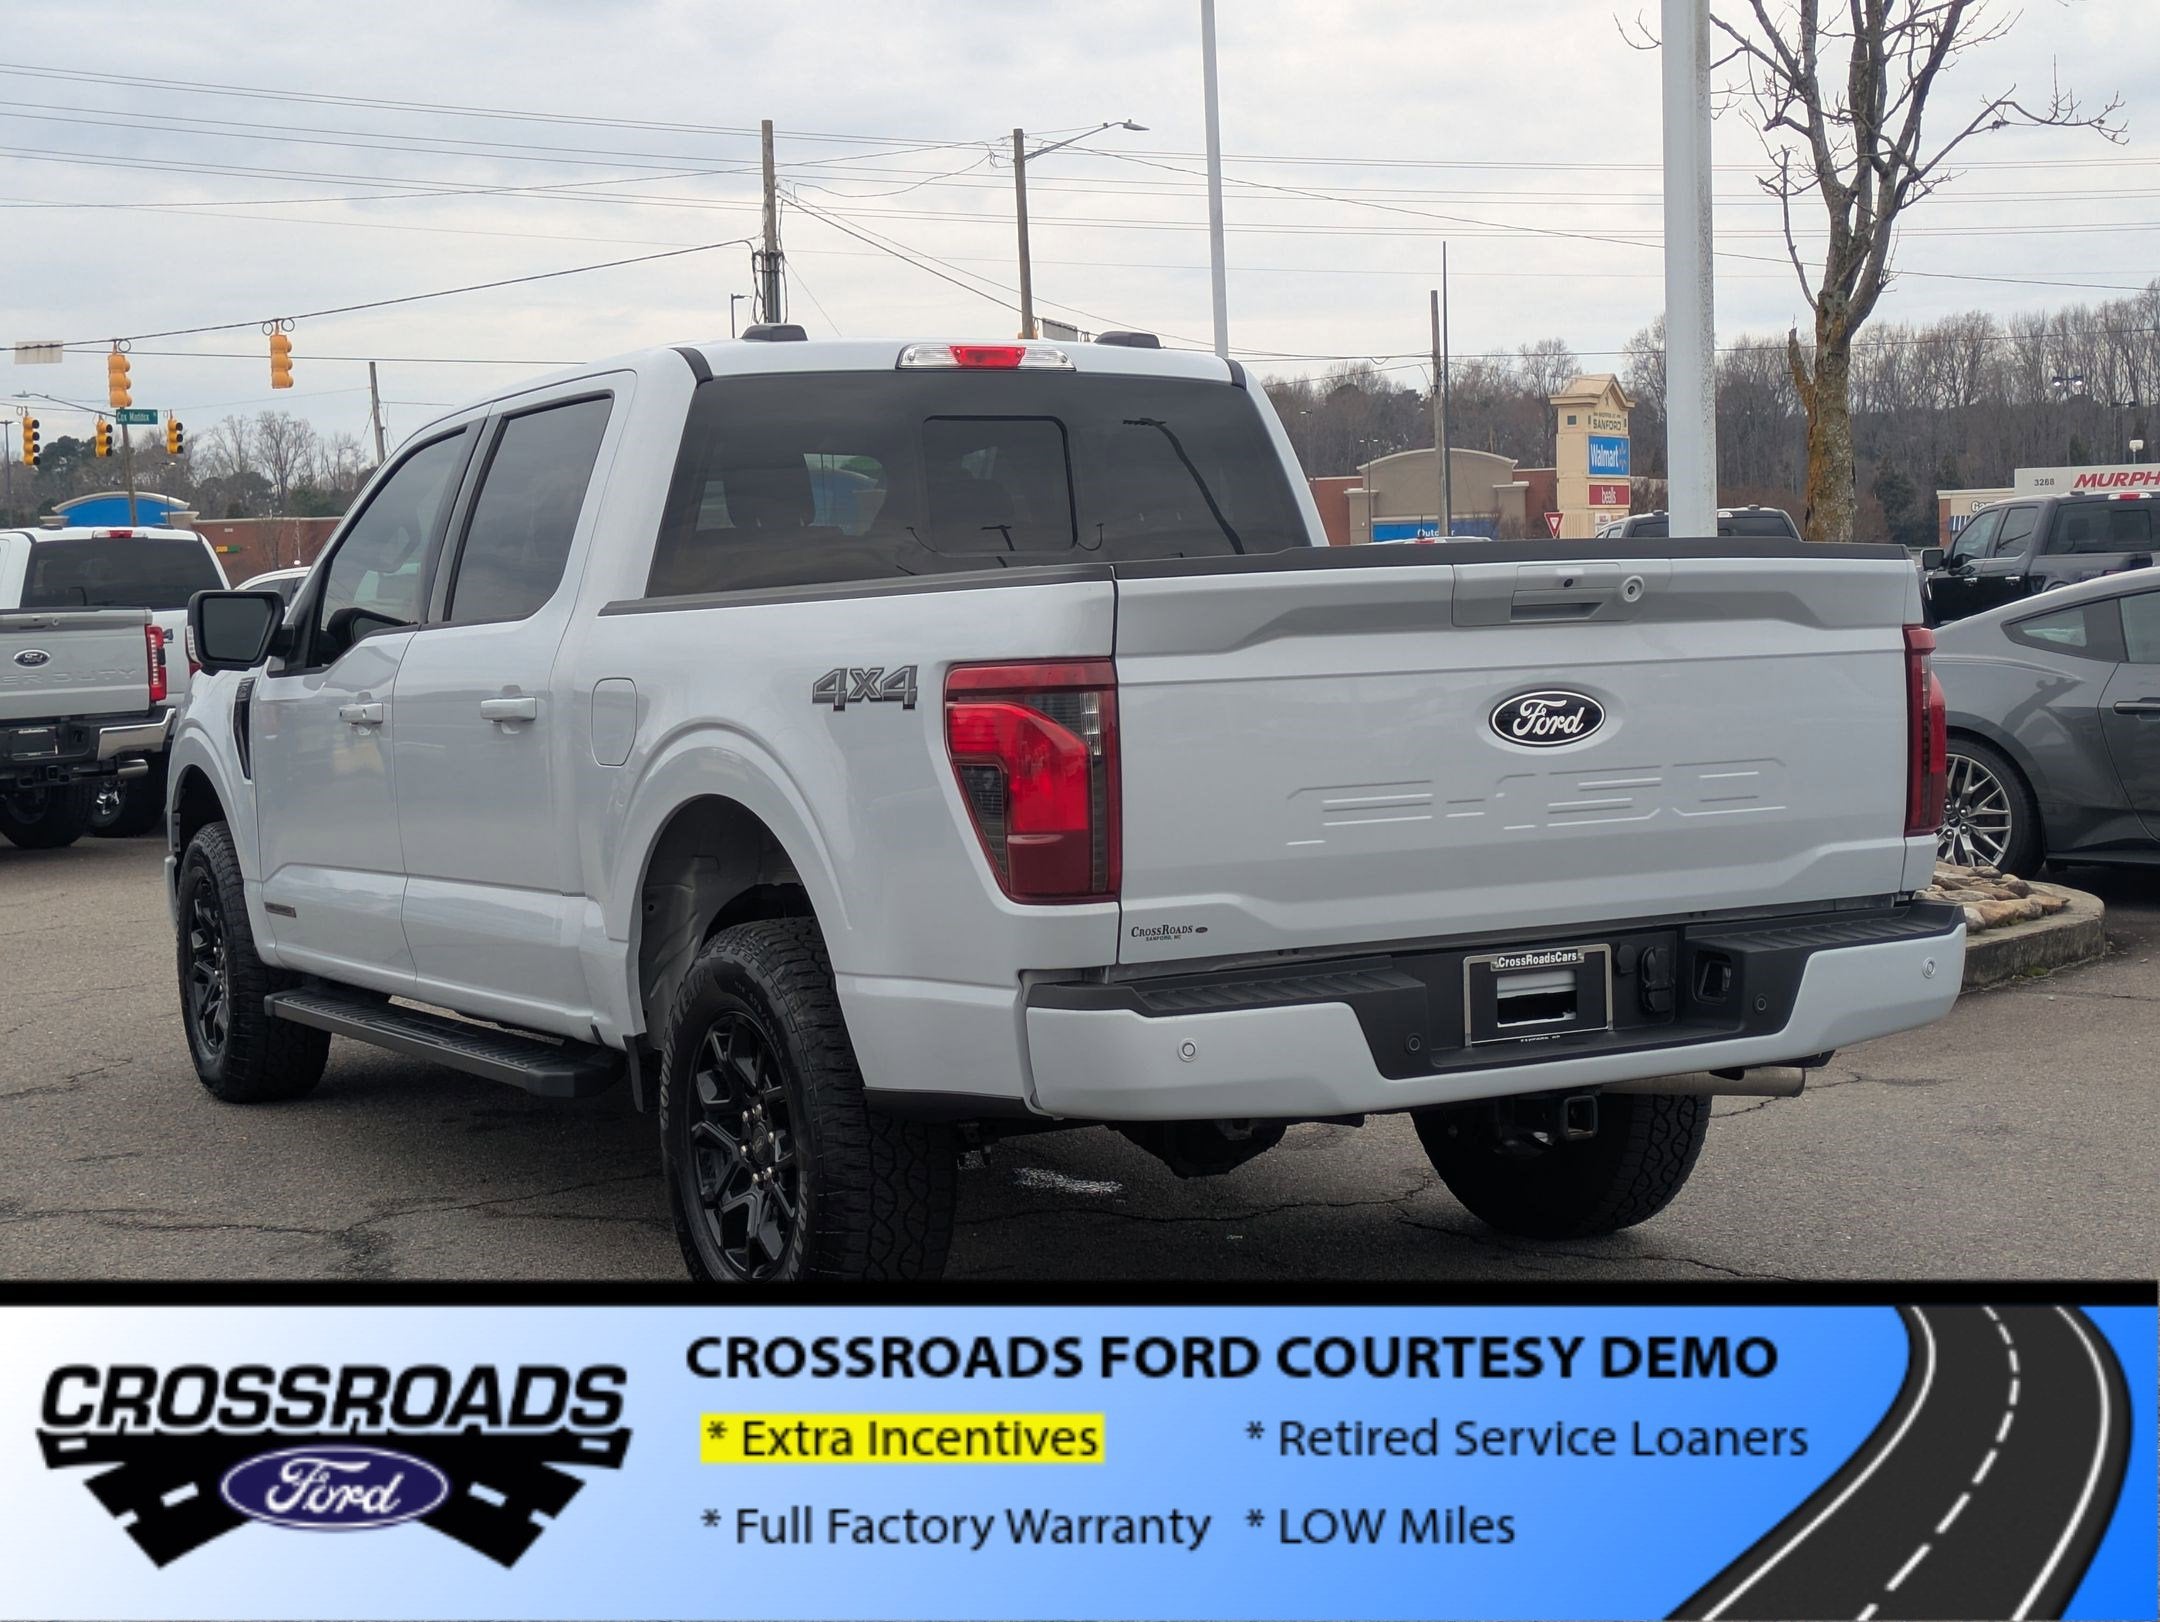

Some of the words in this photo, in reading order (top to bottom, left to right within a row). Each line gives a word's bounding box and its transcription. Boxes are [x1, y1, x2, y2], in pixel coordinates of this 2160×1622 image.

[1593, 418, 1622, 431] SANFORD
[1590, 443, 1619, 468] Walmart
[1512, 698, 1584, 736] Ford
